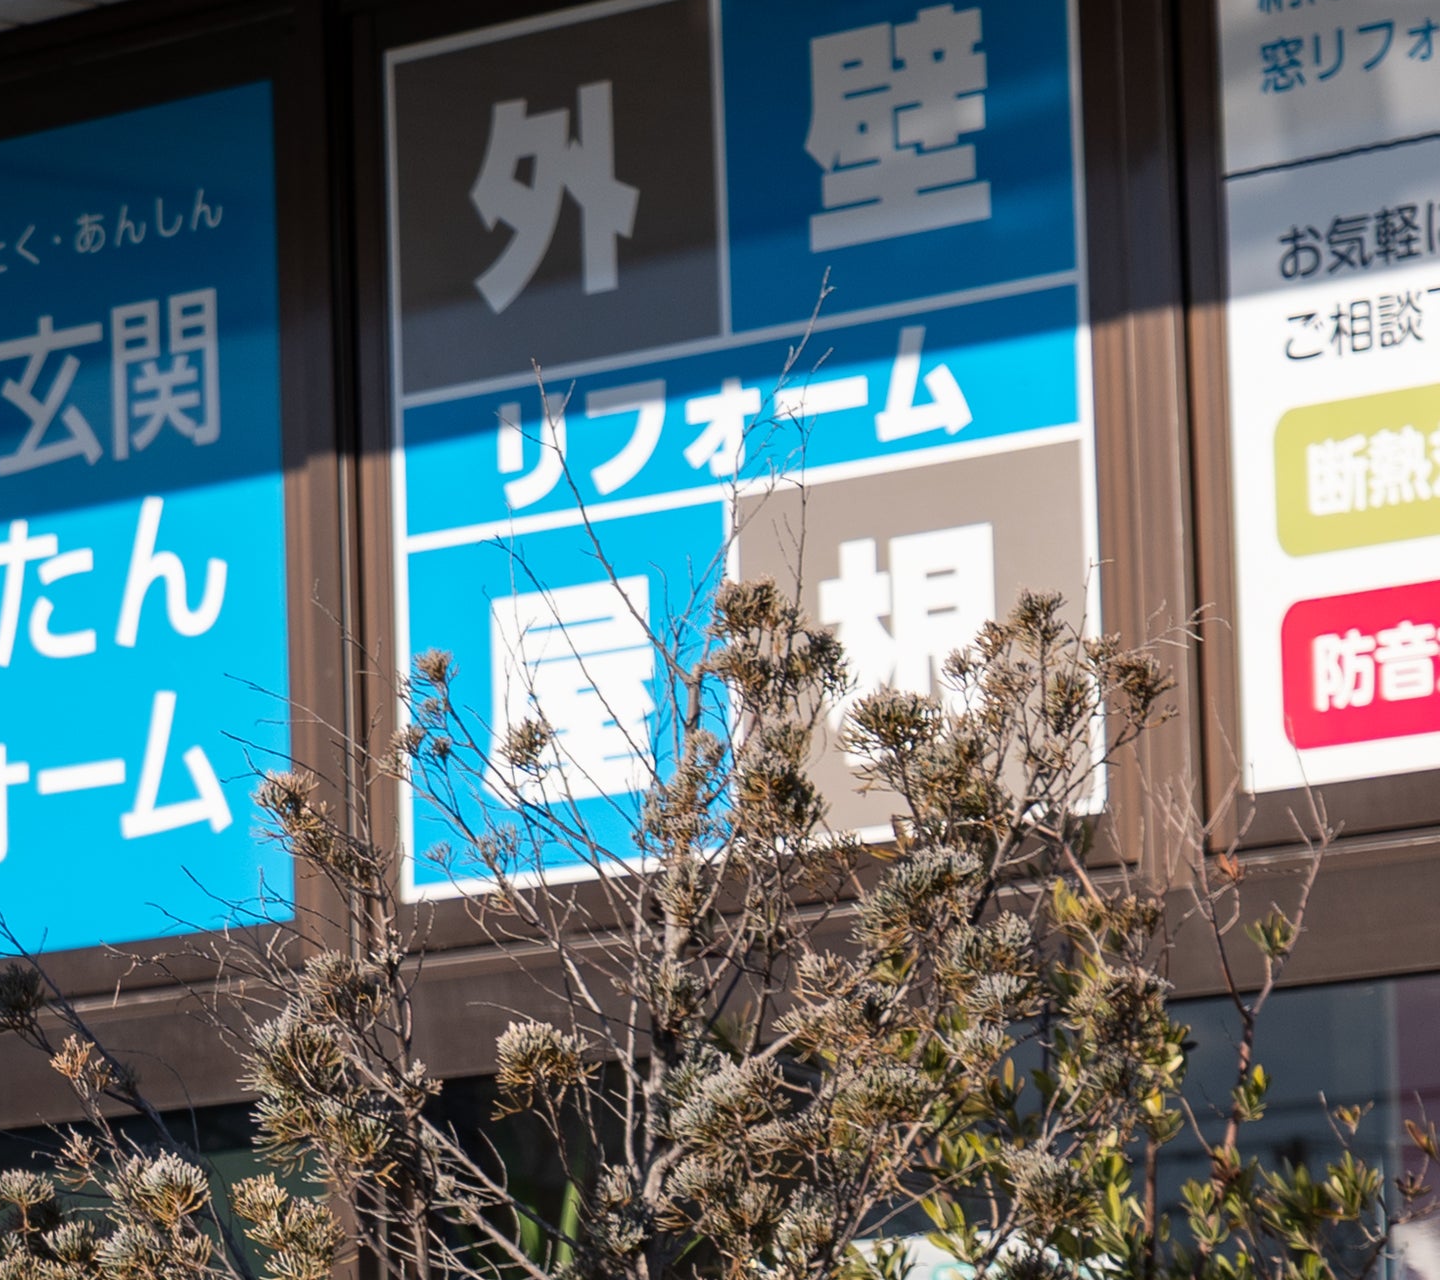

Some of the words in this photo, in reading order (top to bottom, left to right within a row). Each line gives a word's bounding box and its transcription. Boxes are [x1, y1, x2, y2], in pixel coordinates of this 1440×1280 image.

[469, 3, 991, 314] 外壁
[1285, 286, 1440, 362] ご相談
[496, 327, 973, 511] リフォーム
[1306, 422, 1440, 516] 断熱
[1312, 620, 1440, 713] 防音
